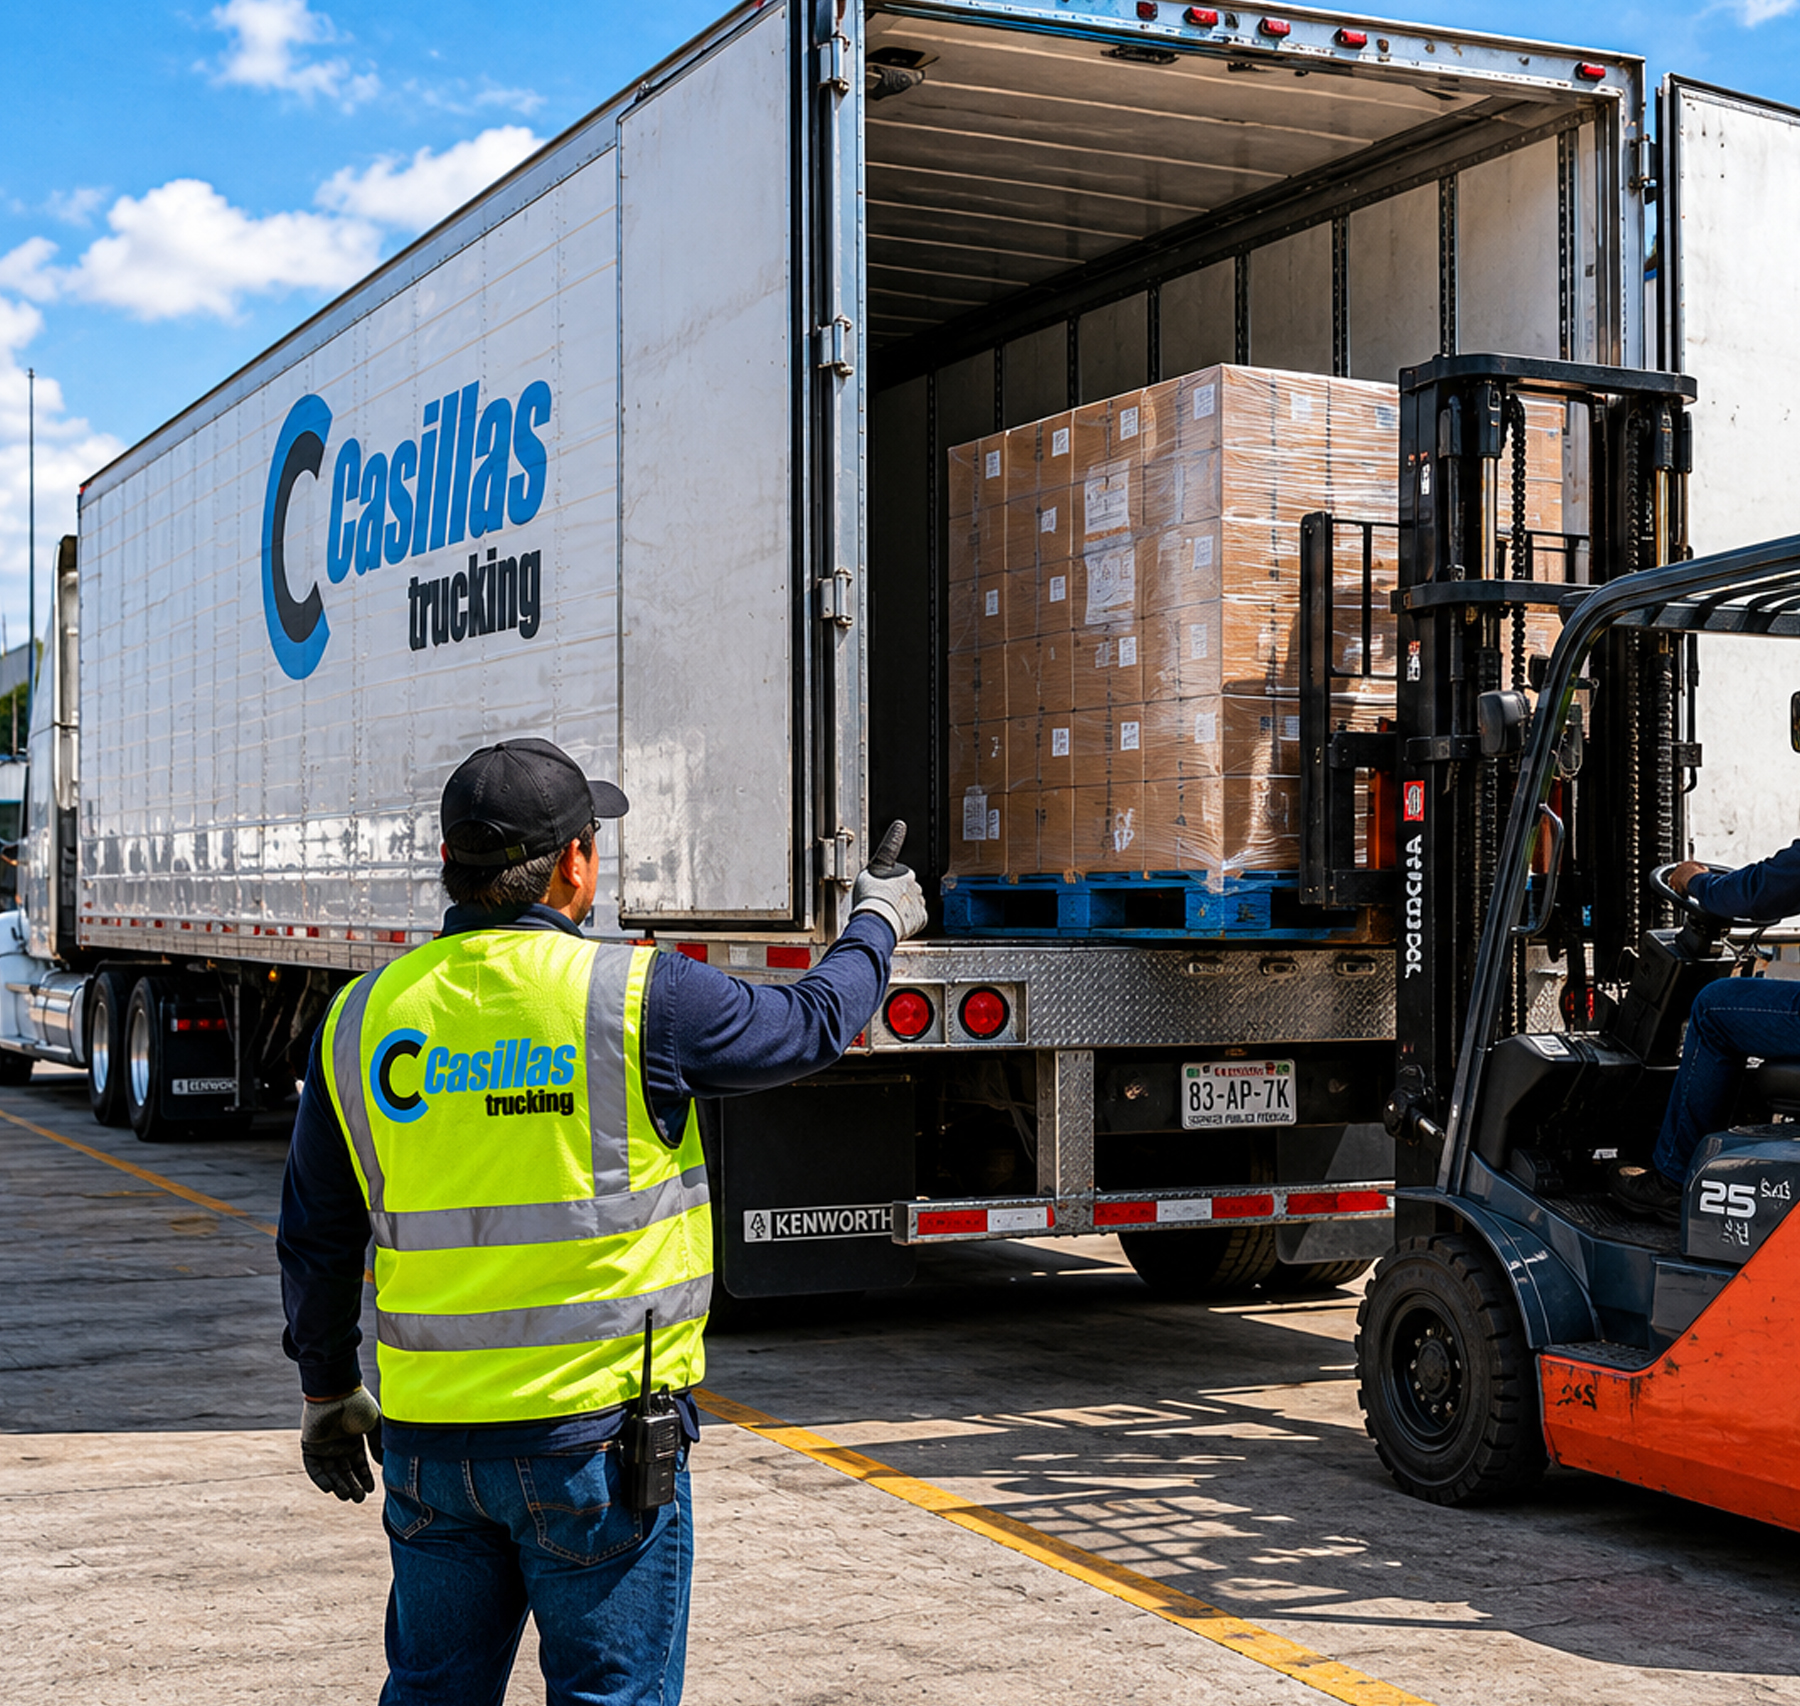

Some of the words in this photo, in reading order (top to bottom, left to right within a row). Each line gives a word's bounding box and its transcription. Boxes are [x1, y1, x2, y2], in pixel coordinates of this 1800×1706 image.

[326, 379, 552, 584] Casillas
[408, 546, 542, 651] trucking
[424, 1037, 577, 1094] Casillas
[485, 1089, 574, 1116] trucking
[1188, 1079, 1290, 1111] 83-AP-7K
[1699, 1180, 1757, 1218] 25
[775, 1208, 893, 1236] KENWORTH
